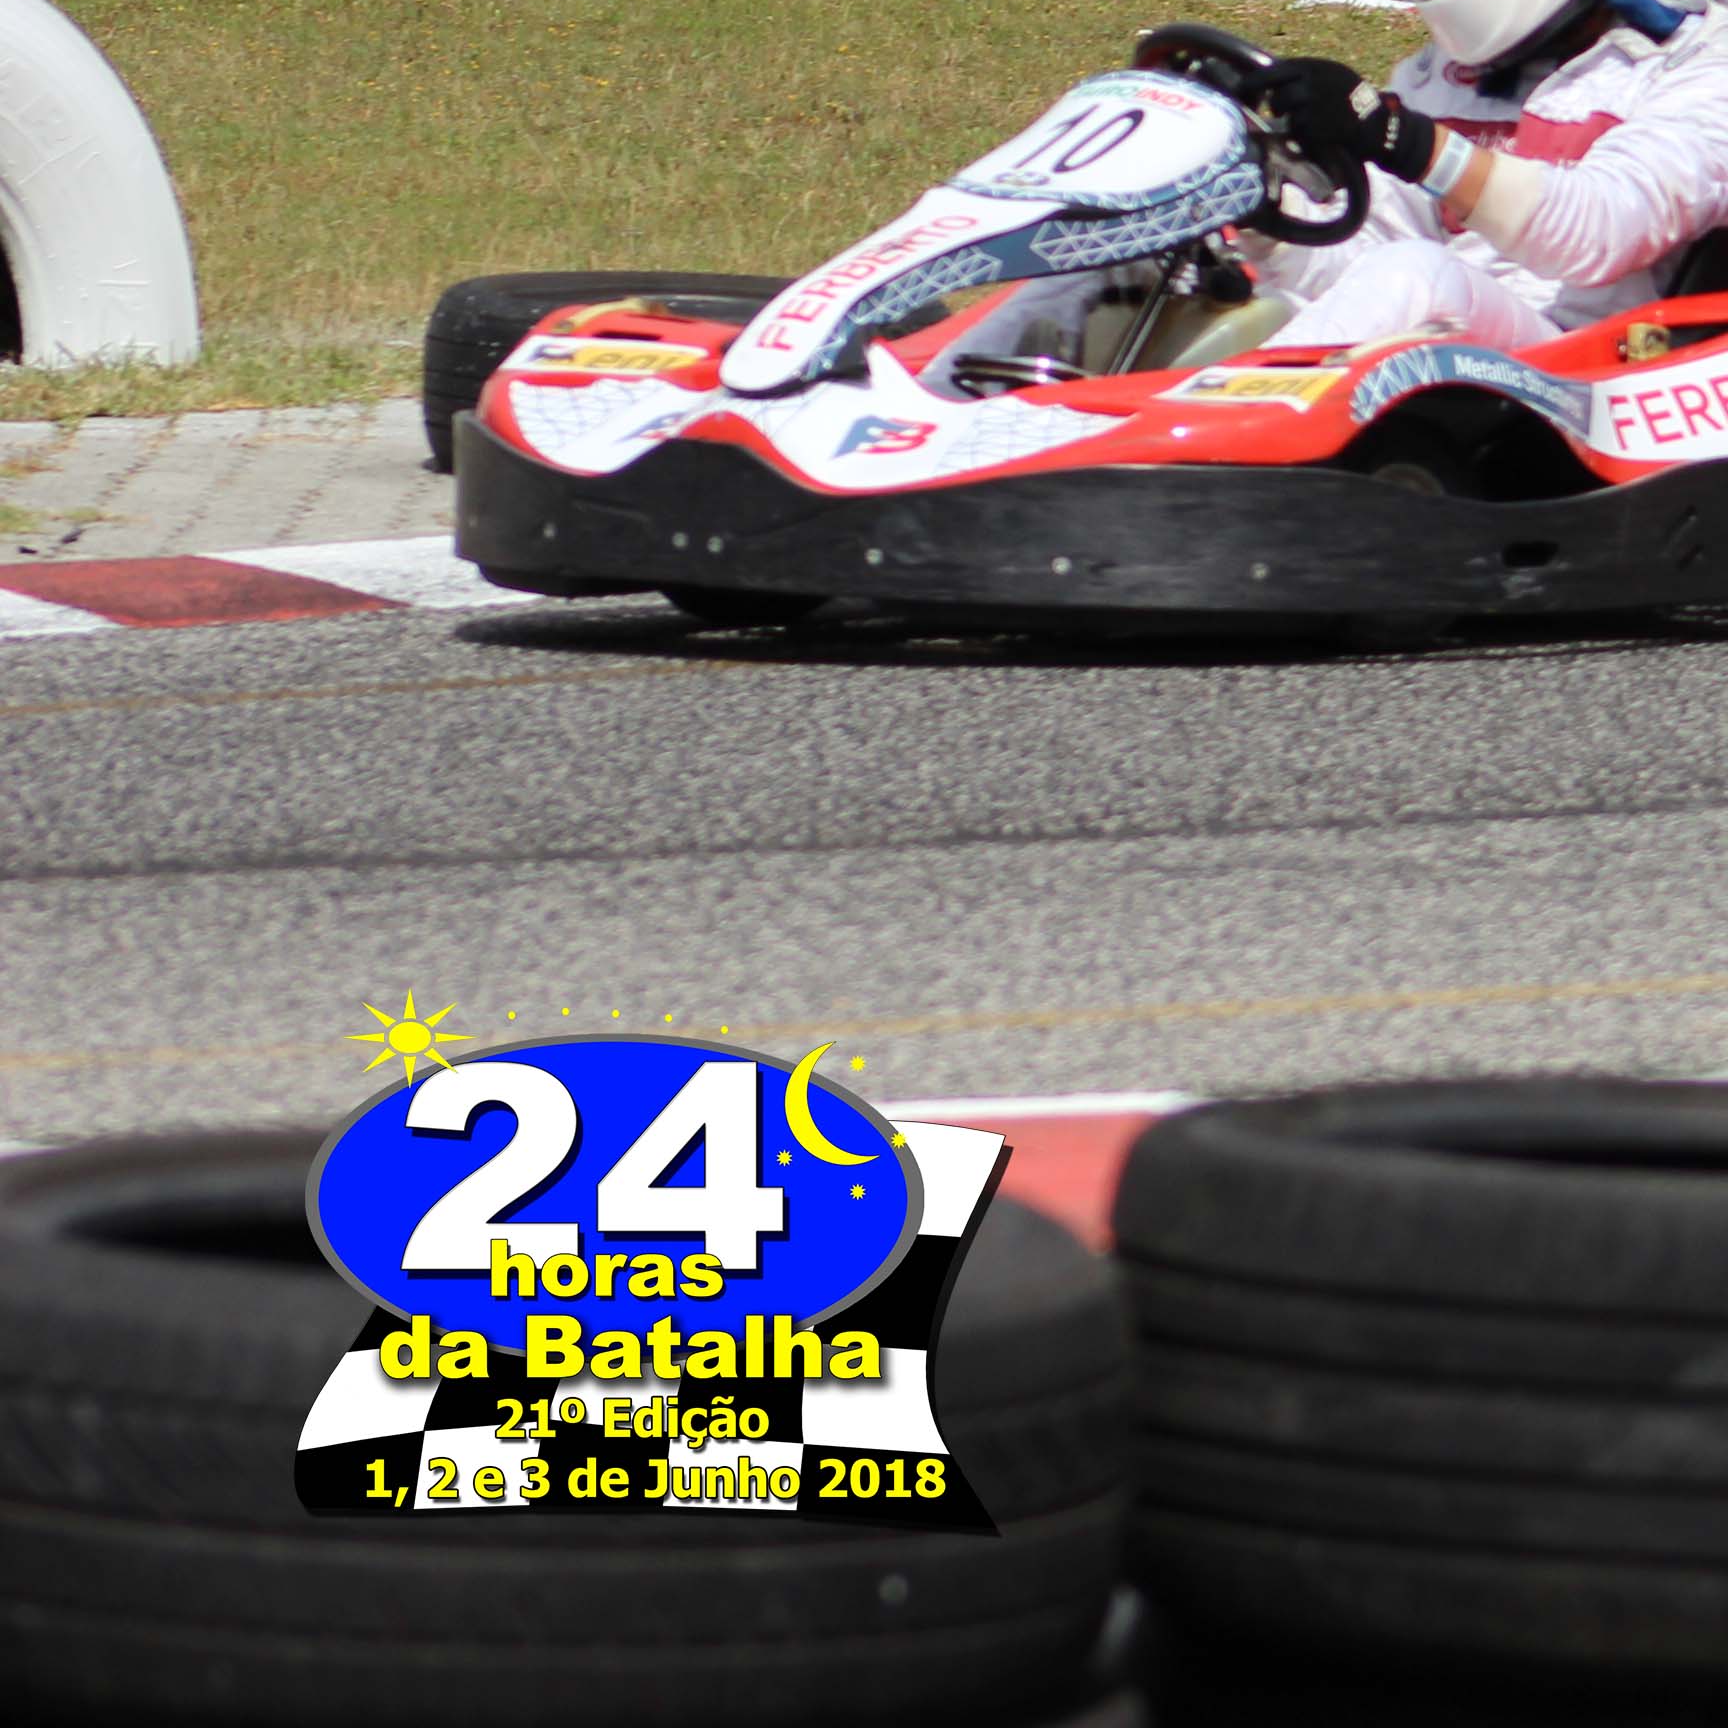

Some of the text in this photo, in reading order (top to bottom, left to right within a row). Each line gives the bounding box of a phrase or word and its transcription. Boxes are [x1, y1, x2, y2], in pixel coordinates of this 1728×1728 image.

[1012, 103, 1146, 174] 10
[756, 215, 981, 352] FERBERTO
[1452, 353, 1523, 389] Metallic
